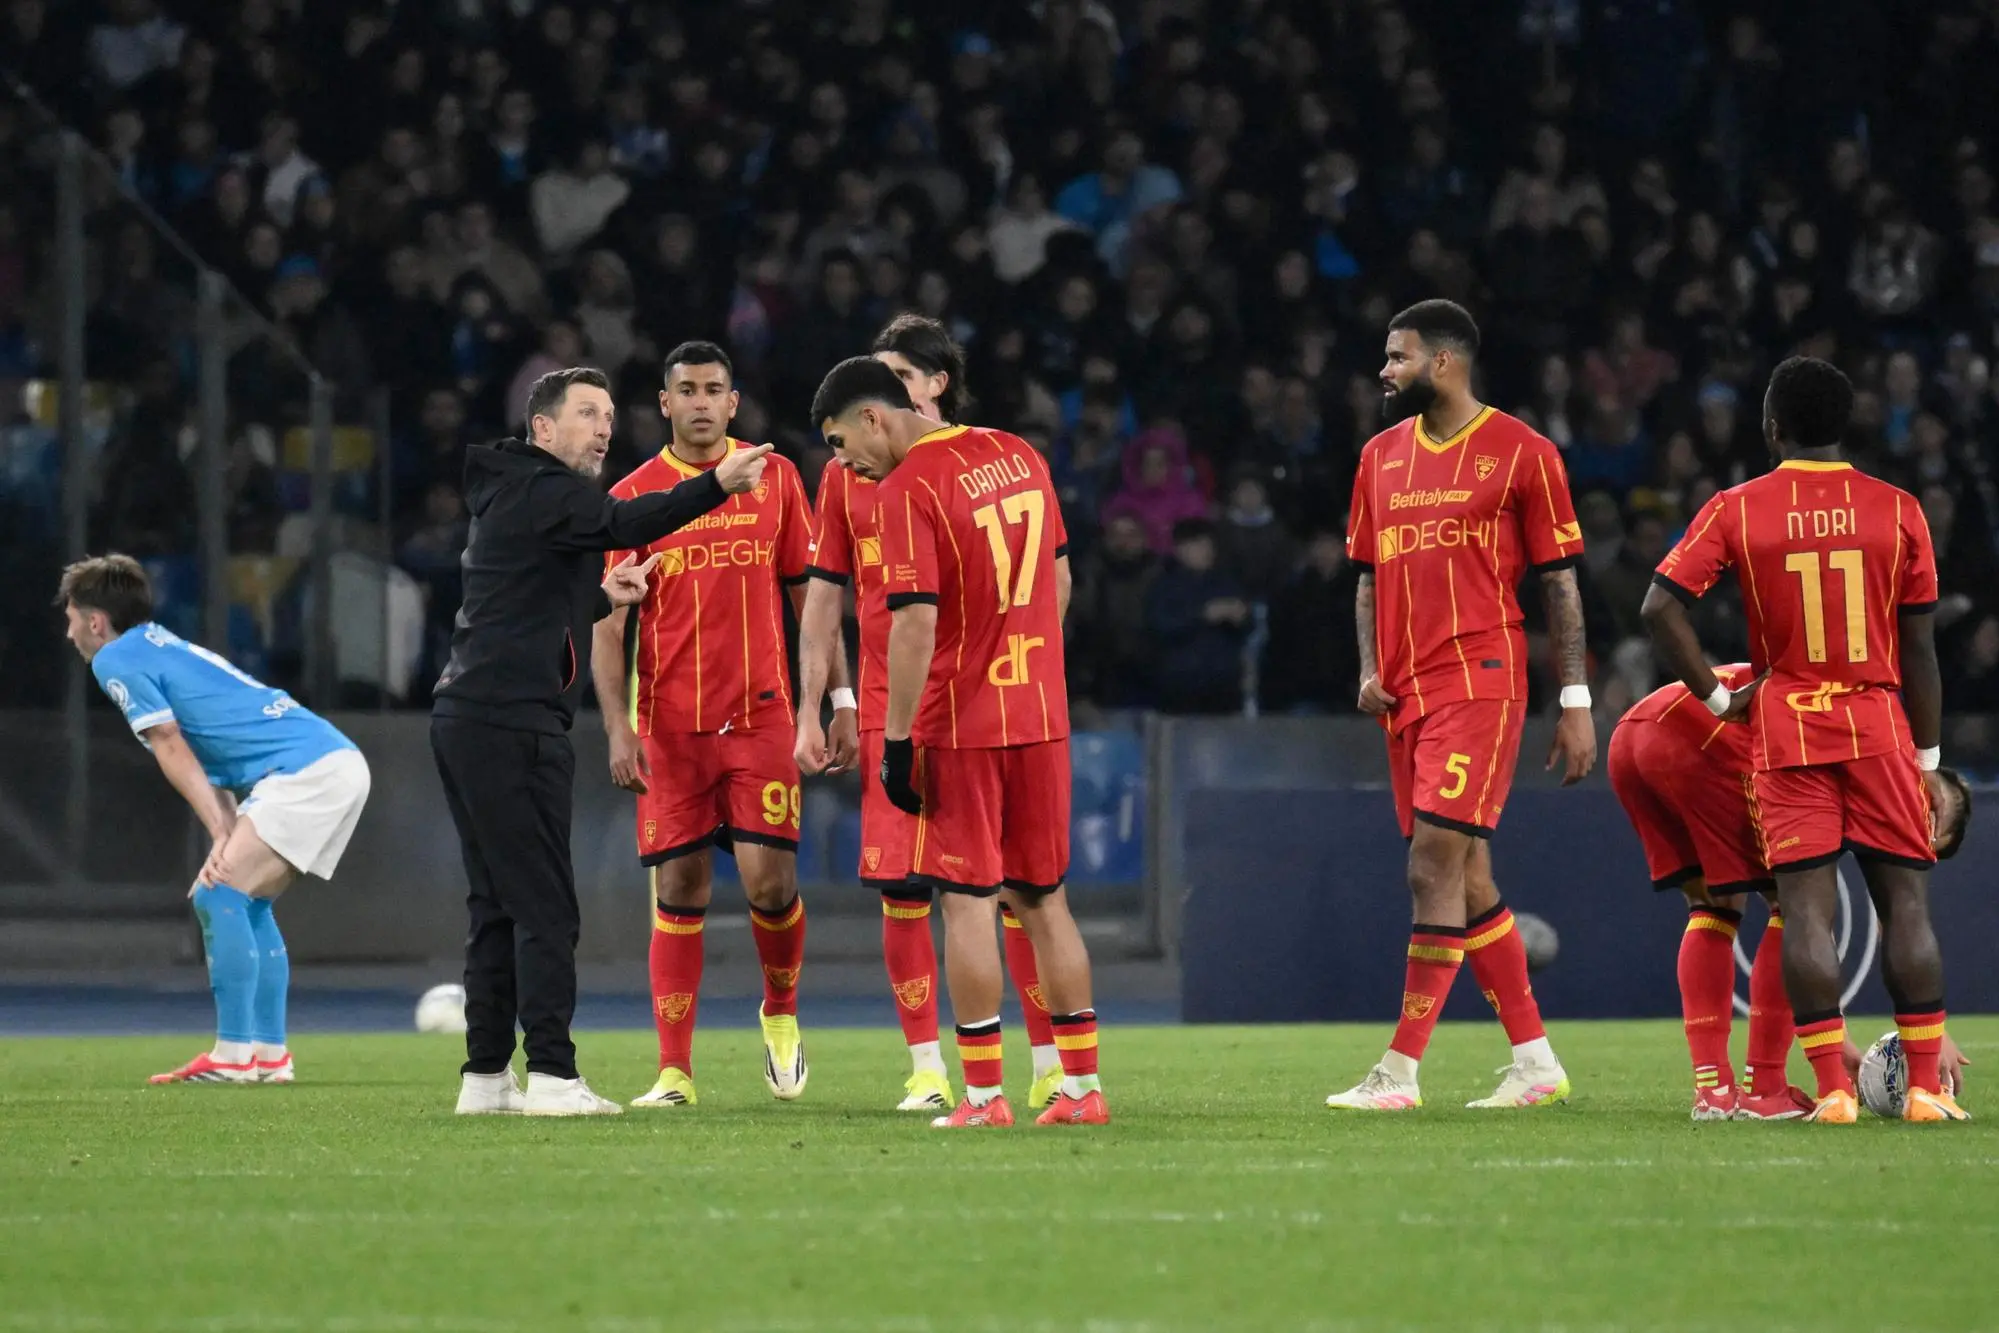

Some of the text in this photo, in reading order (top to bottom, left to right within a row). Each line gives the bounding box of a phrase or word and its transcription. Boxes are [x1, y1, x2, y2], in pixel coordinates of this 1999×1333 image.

[958, 453, 1031, 500] DANILO
[1389, 488, 1447, 511] Betitaly
[672, 512, 734, 535] etitaly
[1399, 518, 1490, 554] DEGHI
[1787, 507, 1857, 540] N'DRI
[973, 490, 1045, 614] 17
[1785, 550, 1868, 663] 11
[1439, 752, 1472, 799] 5
